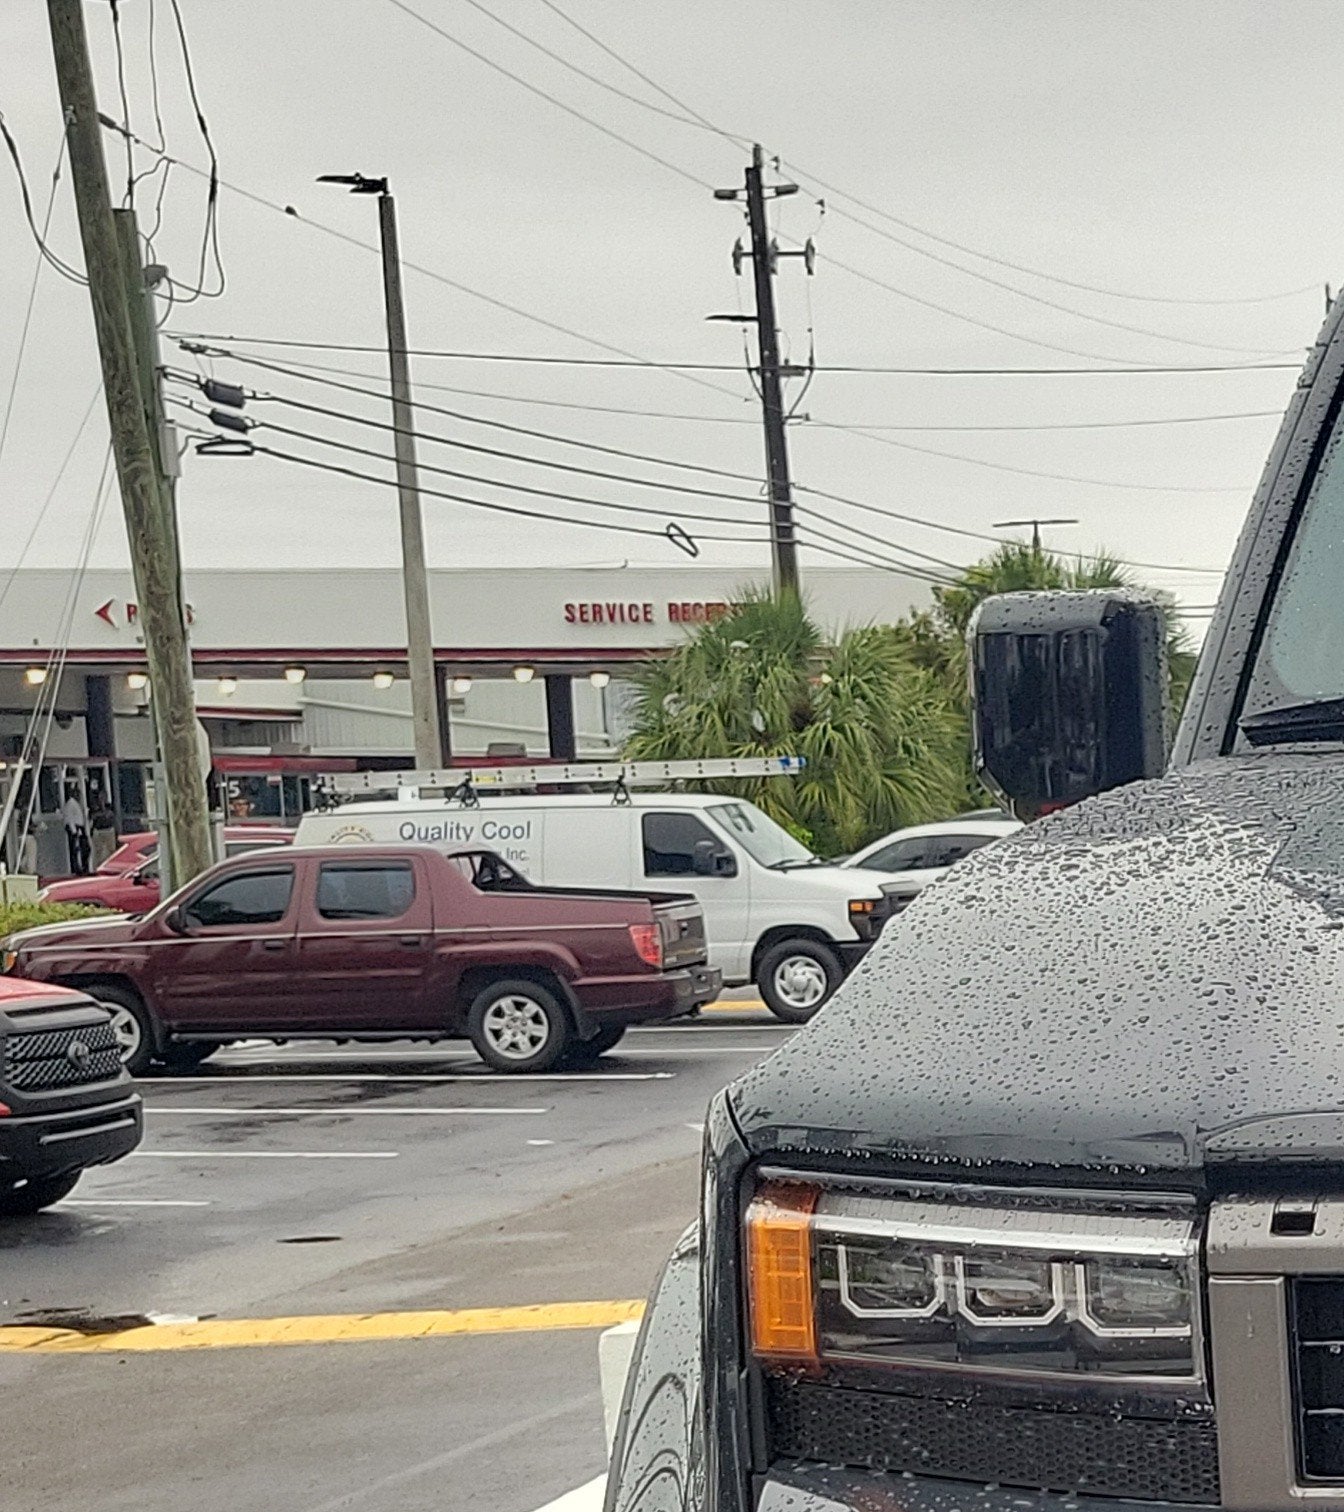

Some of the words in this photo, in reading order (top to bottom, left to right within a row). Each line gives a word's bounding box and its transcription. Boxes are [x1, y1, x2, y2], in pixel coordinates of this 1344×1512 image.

[564, 602, 653, 623] SERVICE
[399, 820, 474, 843] Quality
[482, 819, 532, 840] Cool
